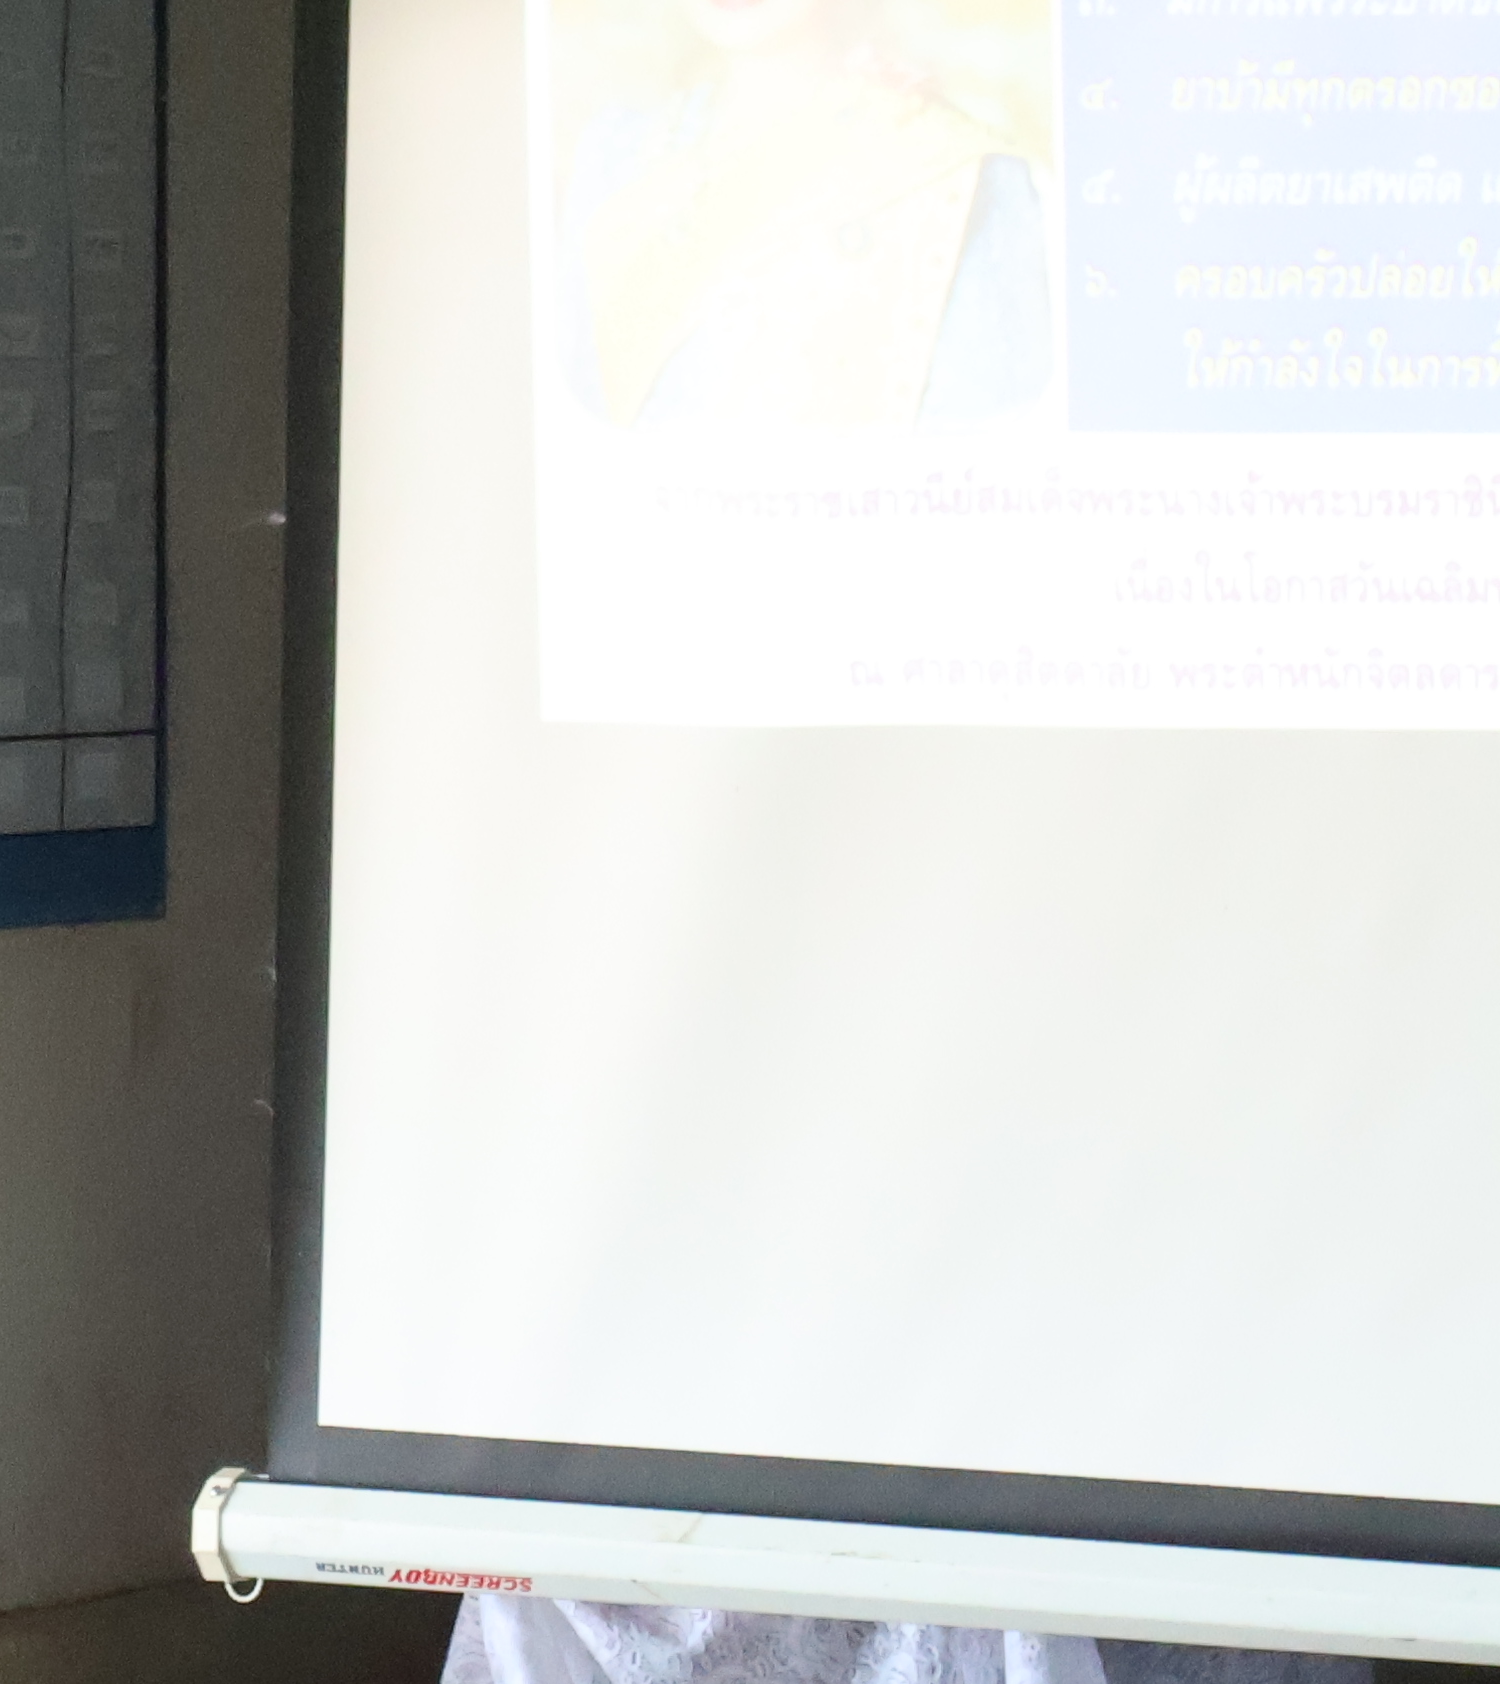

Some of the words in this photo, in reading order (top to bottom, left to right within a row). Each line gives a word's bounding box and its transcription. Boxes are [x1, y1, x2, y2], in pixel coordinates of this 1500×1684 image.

[1174, 236, 1500, 299] ครอบครัวปล่อยให
